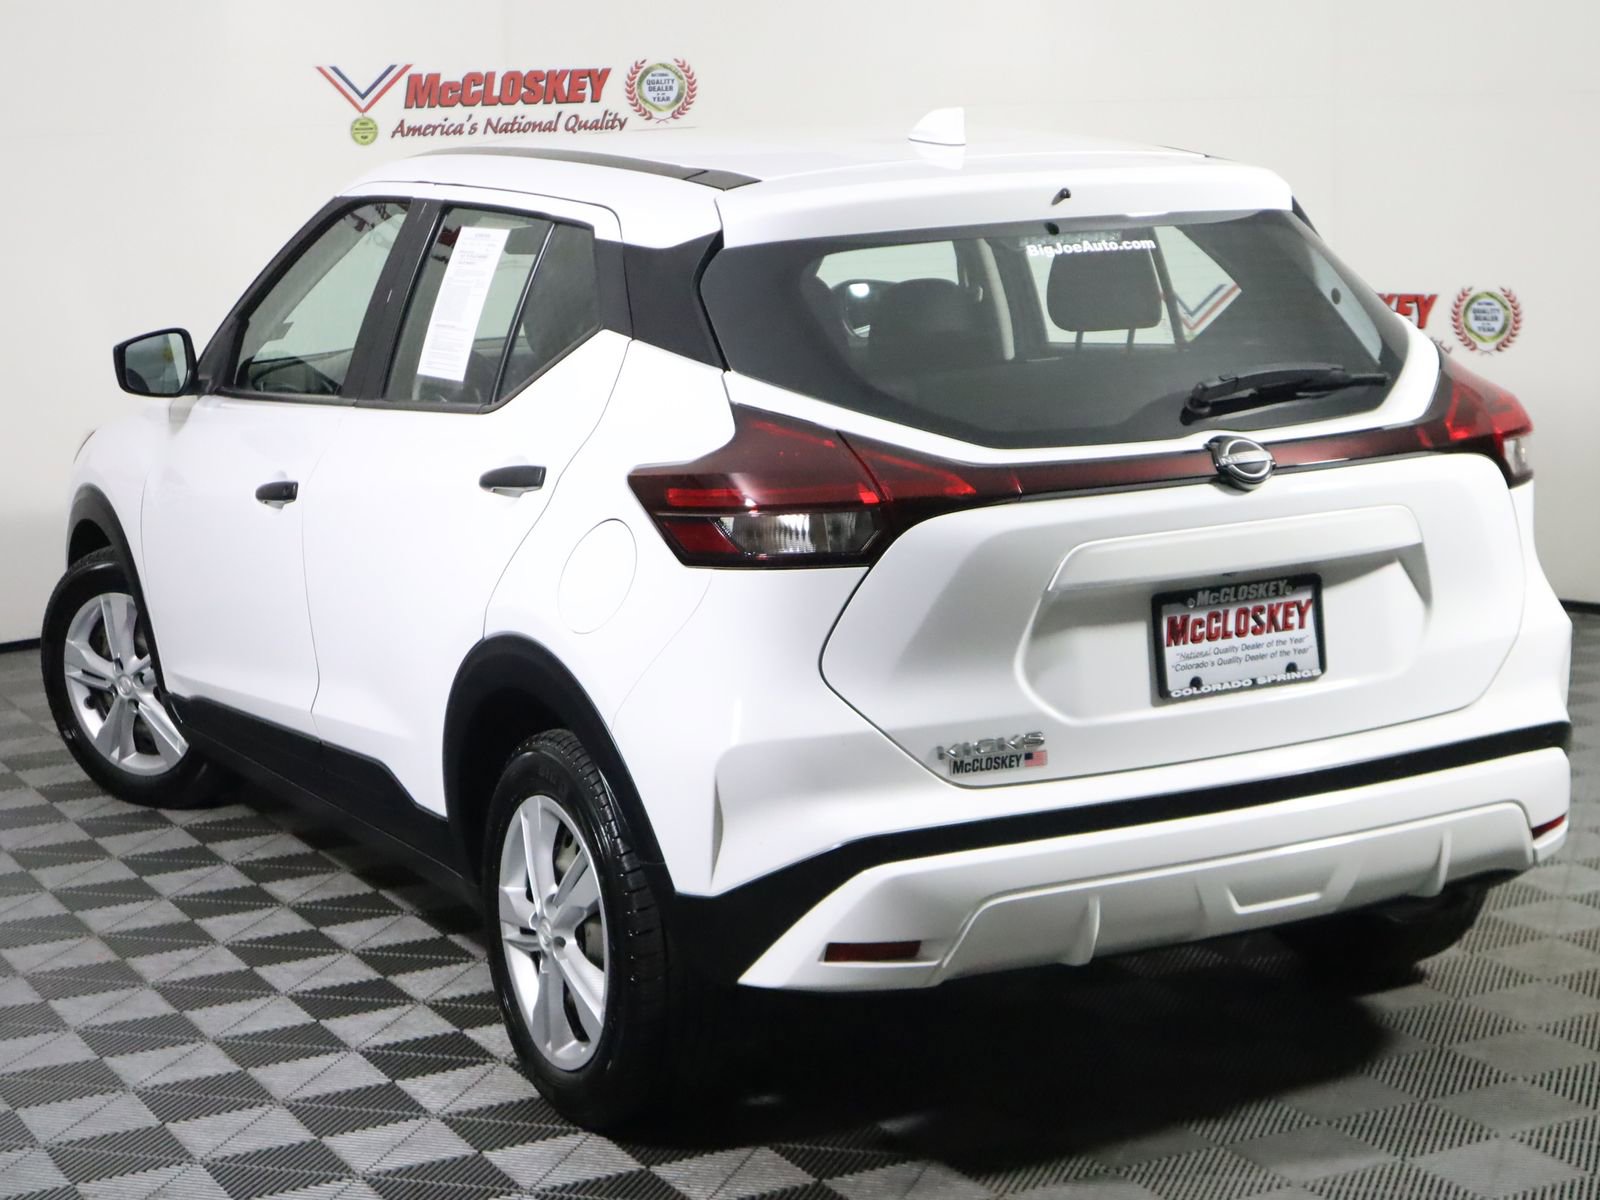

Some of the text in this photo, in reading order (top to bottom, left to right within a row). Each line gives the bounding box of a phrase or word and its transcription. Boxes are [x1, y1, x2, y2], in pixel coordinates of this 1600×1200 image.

[404, 68, 611, 109] McCLOSKEY
[391, 109, 628, 139] America's National Quality
[1025, 239, 1156, 257] BigJoeAuto.com
[1196, 579, 1288, 608] McCLOSKEY
[1166, 599, 1312, 648] McCLOSKEY
[1216, 655, 1243, 668] Quality
[1244, 650, 1269, 663] Dealer
[1270, 649, 1279, 659] of
[1279, 646, 1292, 657] the
[1241, 640, 1265, 652] Dealer
[1266, 637, 1275, 648] of
[1276, 635, 1288, 646] the
[1170, 668, 1322, 698] COLORADO SPRINGS
[952, 754, 1023, 775] McCLOSKEY
